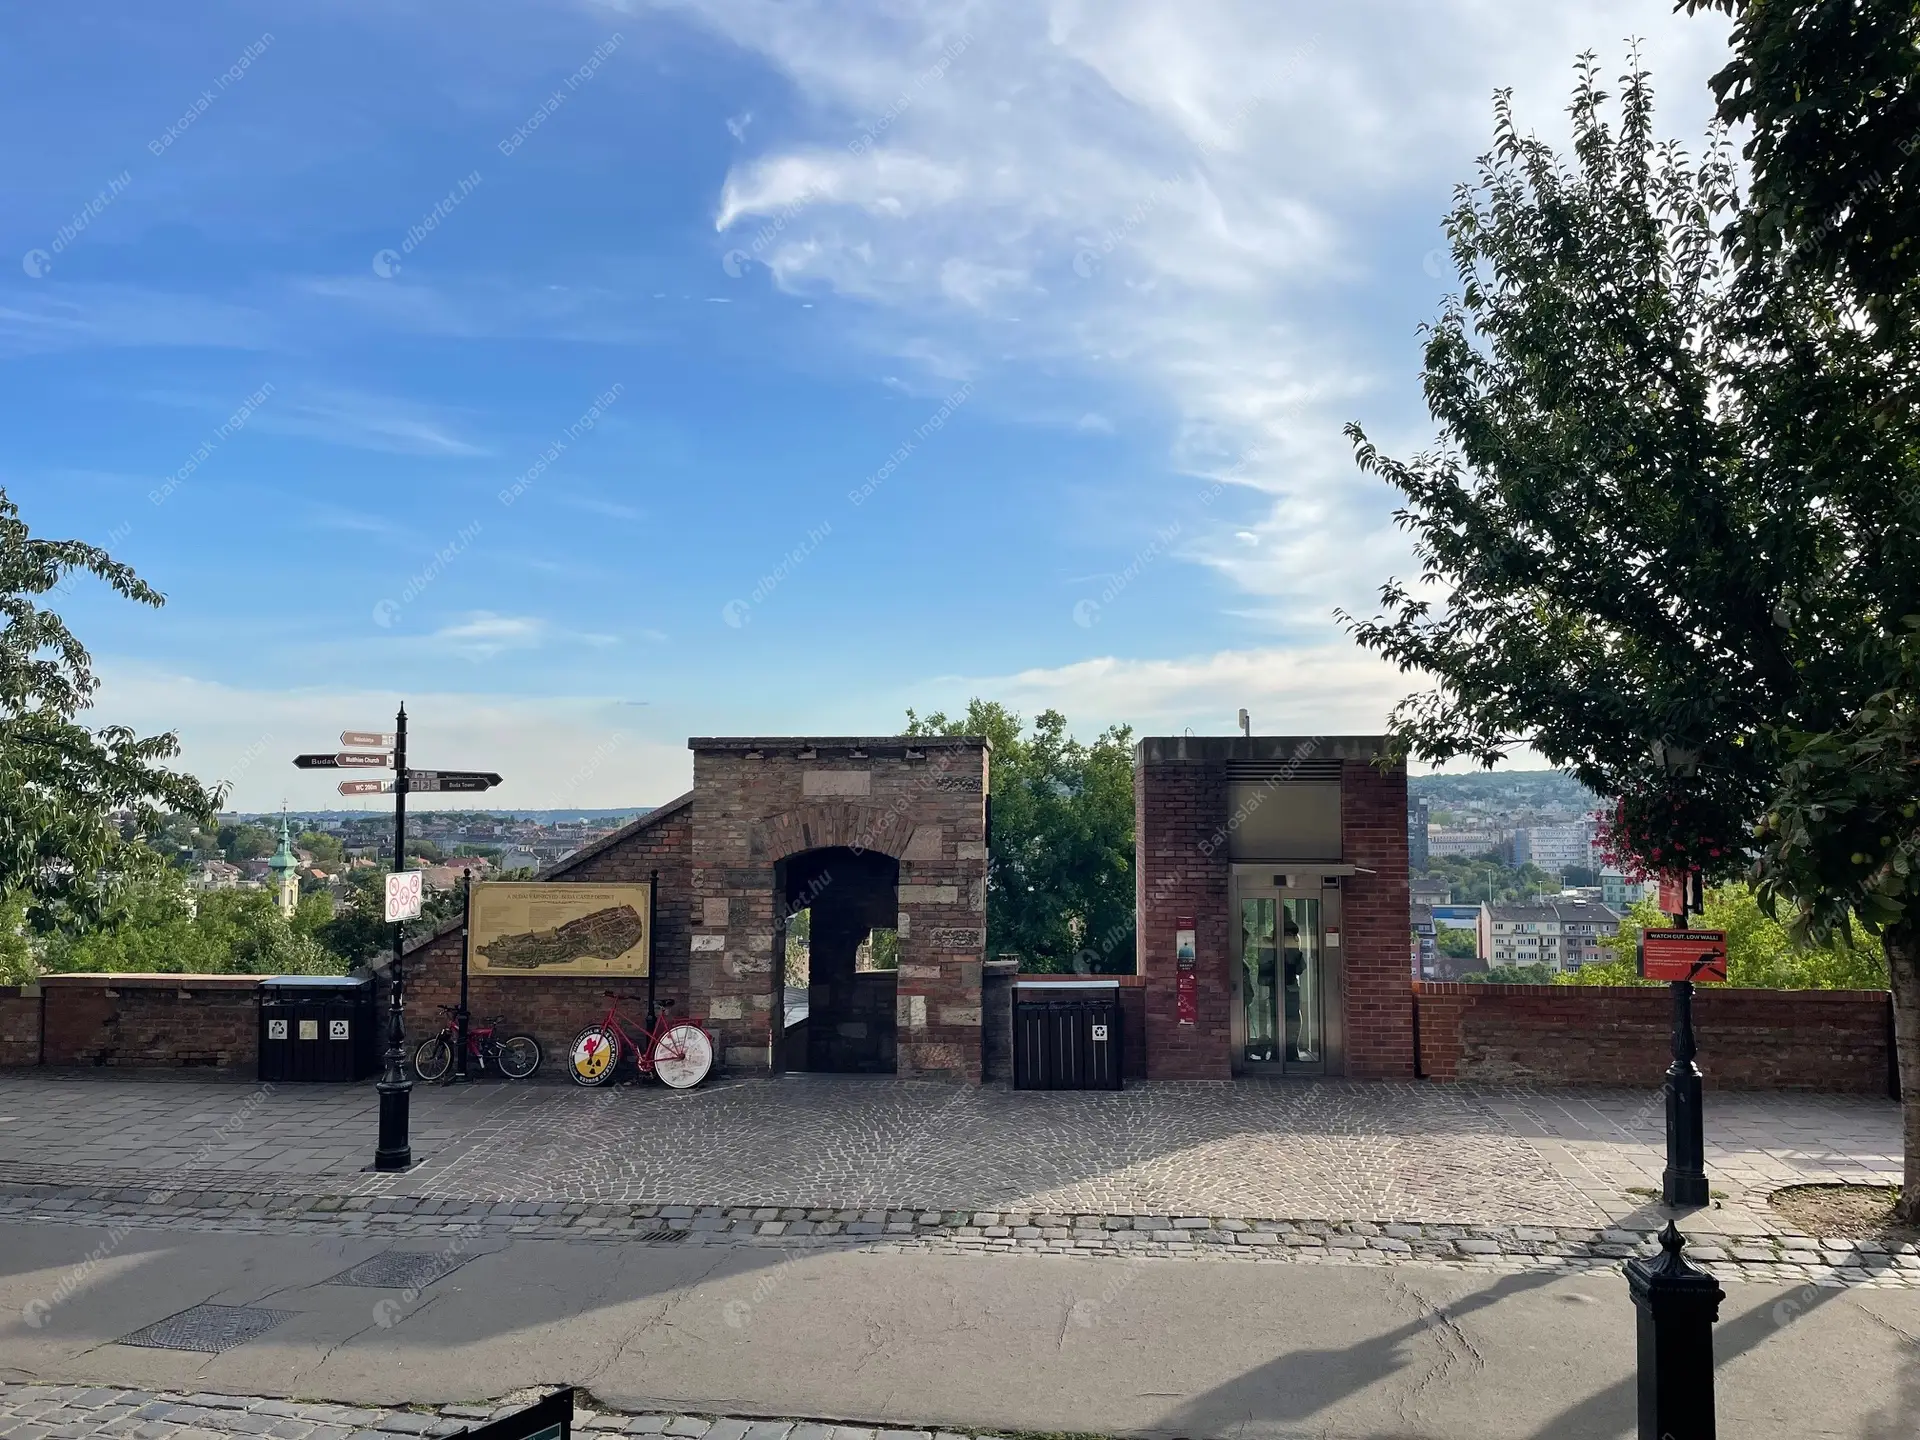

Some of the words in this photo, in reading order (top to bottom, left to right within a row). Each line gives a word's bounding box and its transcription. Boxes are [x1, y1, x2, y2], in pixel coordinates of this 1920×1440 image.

[573, 1029, 593, 1052] HOSPITAL
[608, 1036, 616, 1052] ROCK
[599, 1052, 616, 1079] NUCLEAR
